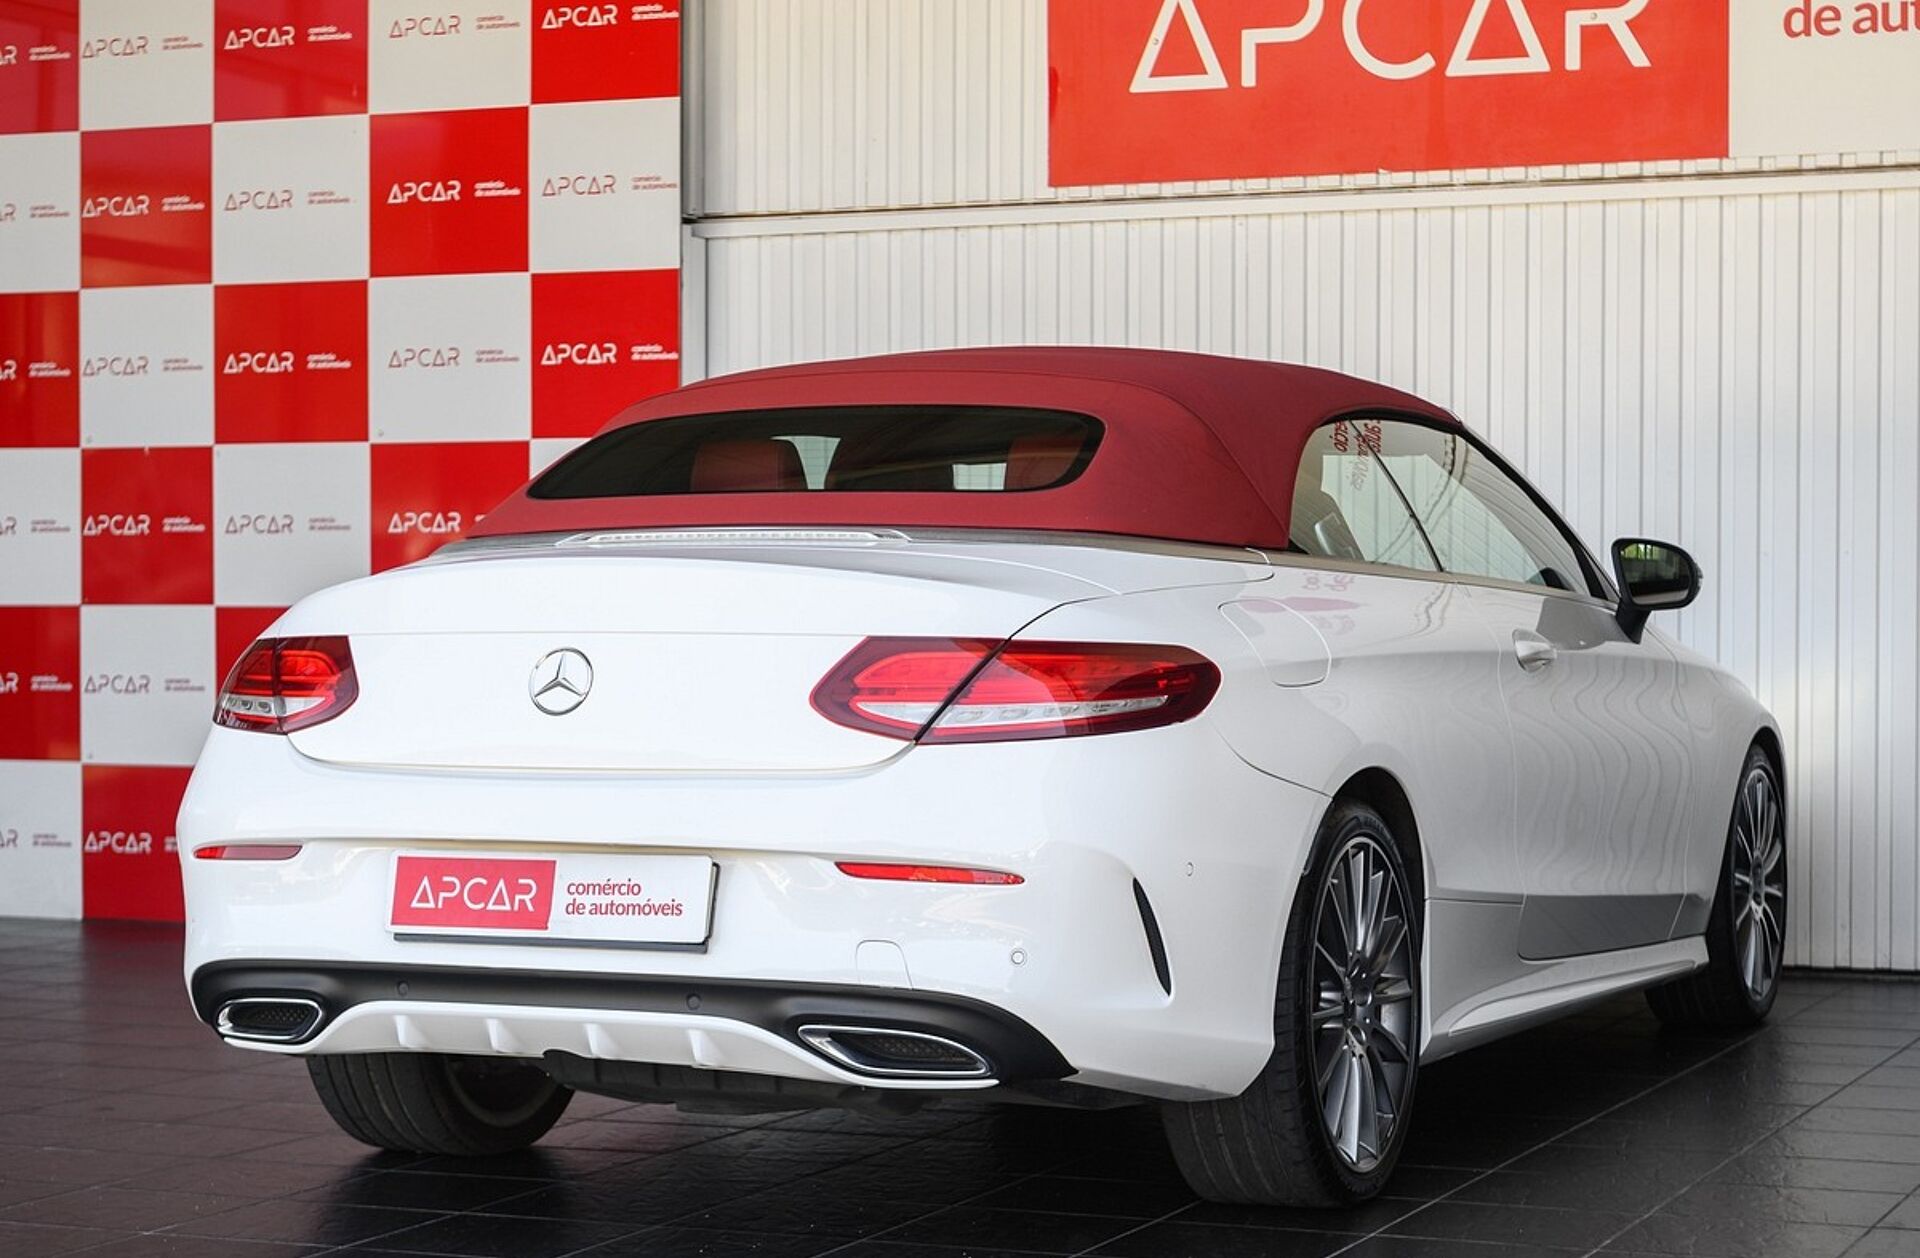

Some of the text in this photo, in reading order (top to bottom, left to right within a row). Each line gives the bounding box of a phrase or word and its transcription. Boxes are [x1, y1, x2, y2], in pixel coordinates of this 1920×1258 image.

[389, 15, 461, 38] APCAR
[542, 5, 617, 29] APCAR
[1783, 0, 1842, 38] de
[82, 36, 148, 58] APCAR
[224, 26, 295, 50] APCAR
[1129, 0, 1652, 92] APCAR
[388, 180, 461, 204] APCAR
[542, 175, 616, 197] APCAR
[82, 195, 149, 218] APCAR
[224, 190, 293, 212] APCAR
[224, 352, 294, 374] APCAR
[388, 347, 460, 368] APCAR
[541, 343, 617, 365] APCAR
[82, 356, 148, 376] APCAR
[83, 514, 150, 536] APCAR
[225, 514, 294, 534] APCAR
[388, 511, 461, 533] APCAR
[84, 674, 150, 694] APCAR
[84, 831, 152, 853] APCAR
[410, 876, 538, 912] APCAR
[567, 878, 642, 897] comércio
[565, 897, 683, 917] de automóveis
